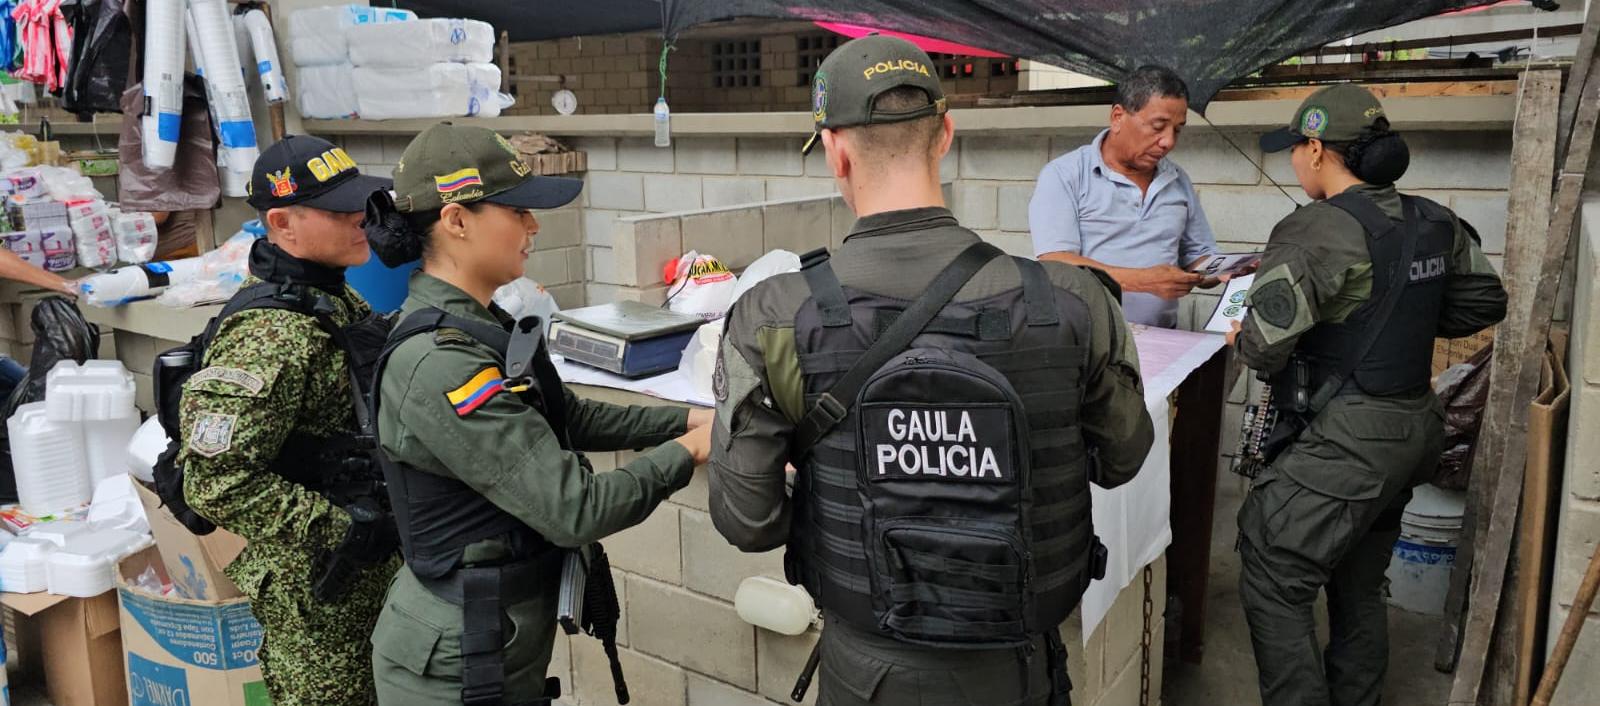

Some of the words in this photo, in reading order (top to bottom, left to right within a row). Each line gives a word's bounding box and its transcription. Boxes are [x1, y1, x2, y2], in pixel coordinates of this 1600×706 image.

[864, 60, 931, 80] POLICIA
[440, 190, 484, 203] Colombia
[1408, 256, 1446, 281] OLICIA
[887, 408, 977, 442] GAULA
[876, 443, 1003, 477] POLICIA
[193, 651, 218, 666] 500
